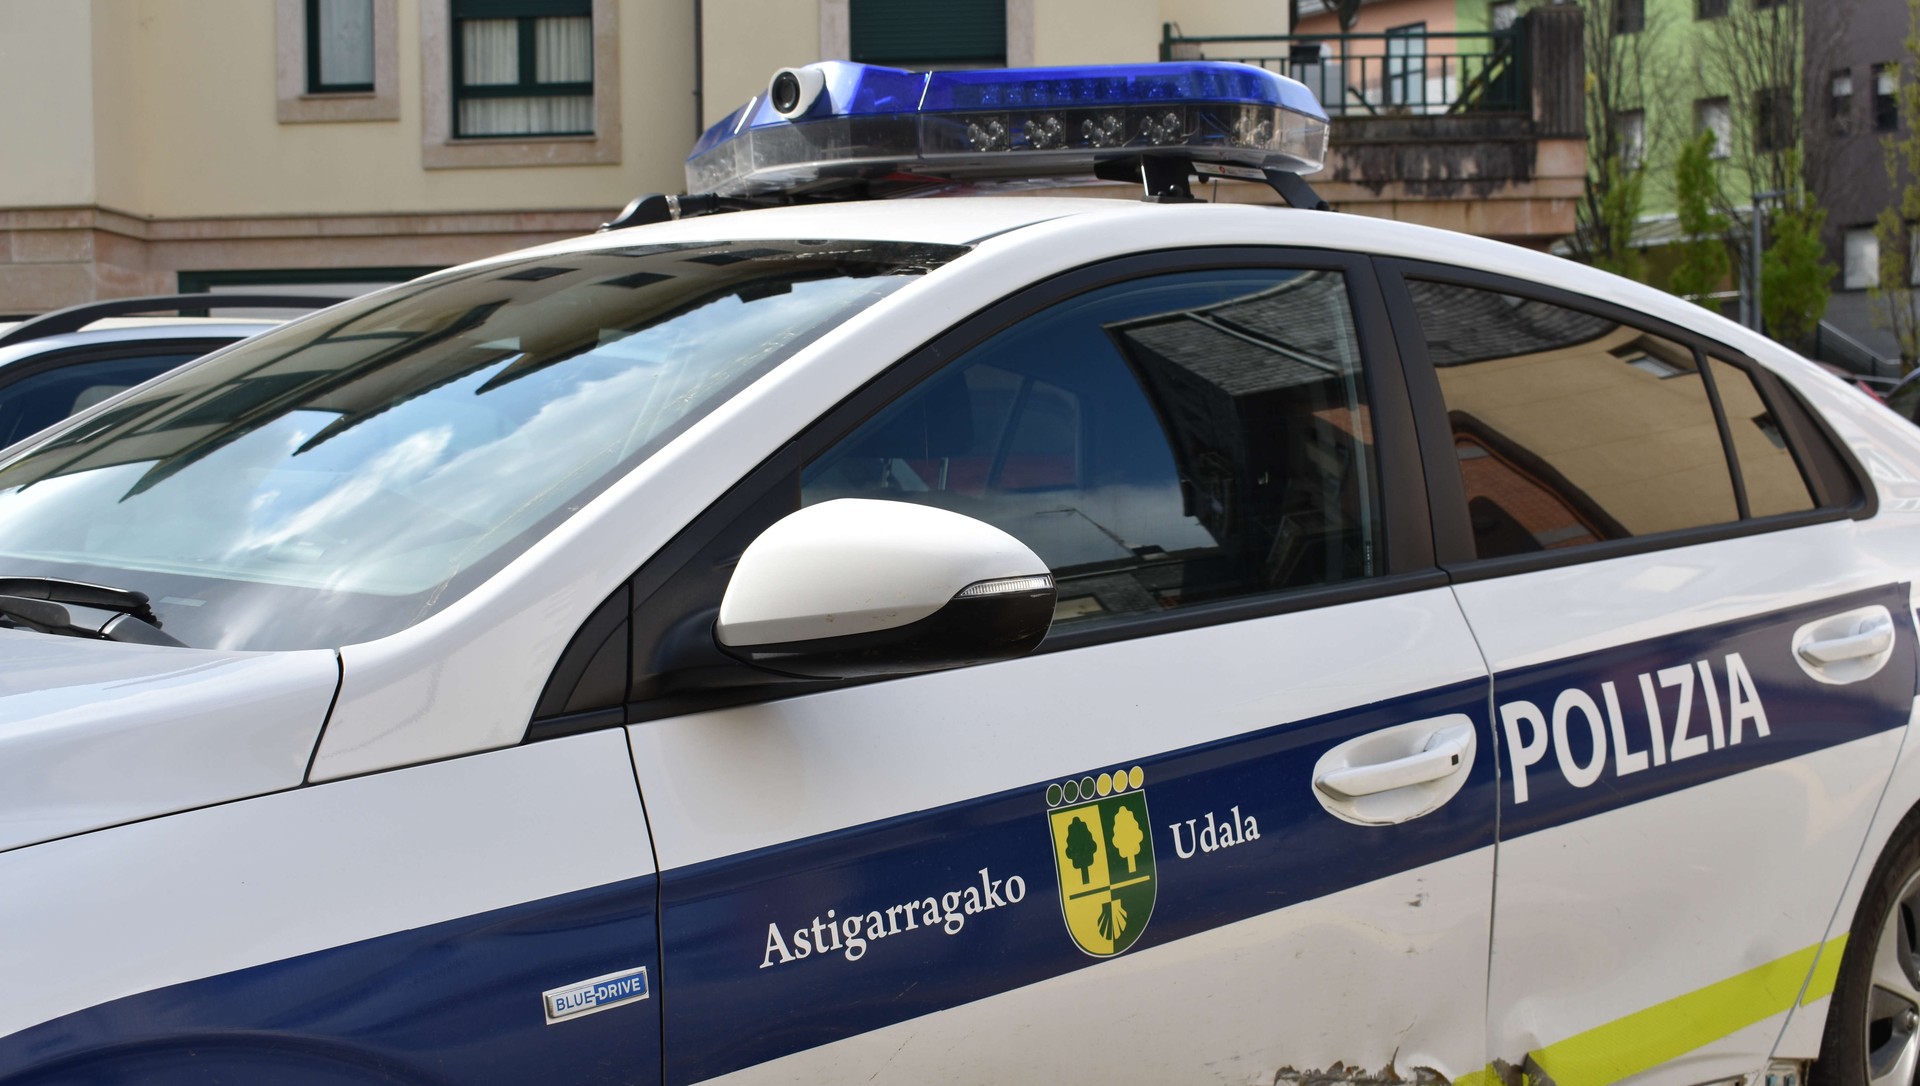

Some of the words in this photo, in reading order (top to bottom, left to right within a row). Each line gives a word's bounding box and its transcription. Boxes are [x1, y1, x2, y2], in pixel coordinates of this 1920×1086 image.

[1500, 652, 1771, 805] POLIZIA
[759, 867, 1026, 969] Astigarragako
[1169, 805, 1261, 859] Udala
[556, 977, 641, 1012] BLUE-DRIVE
